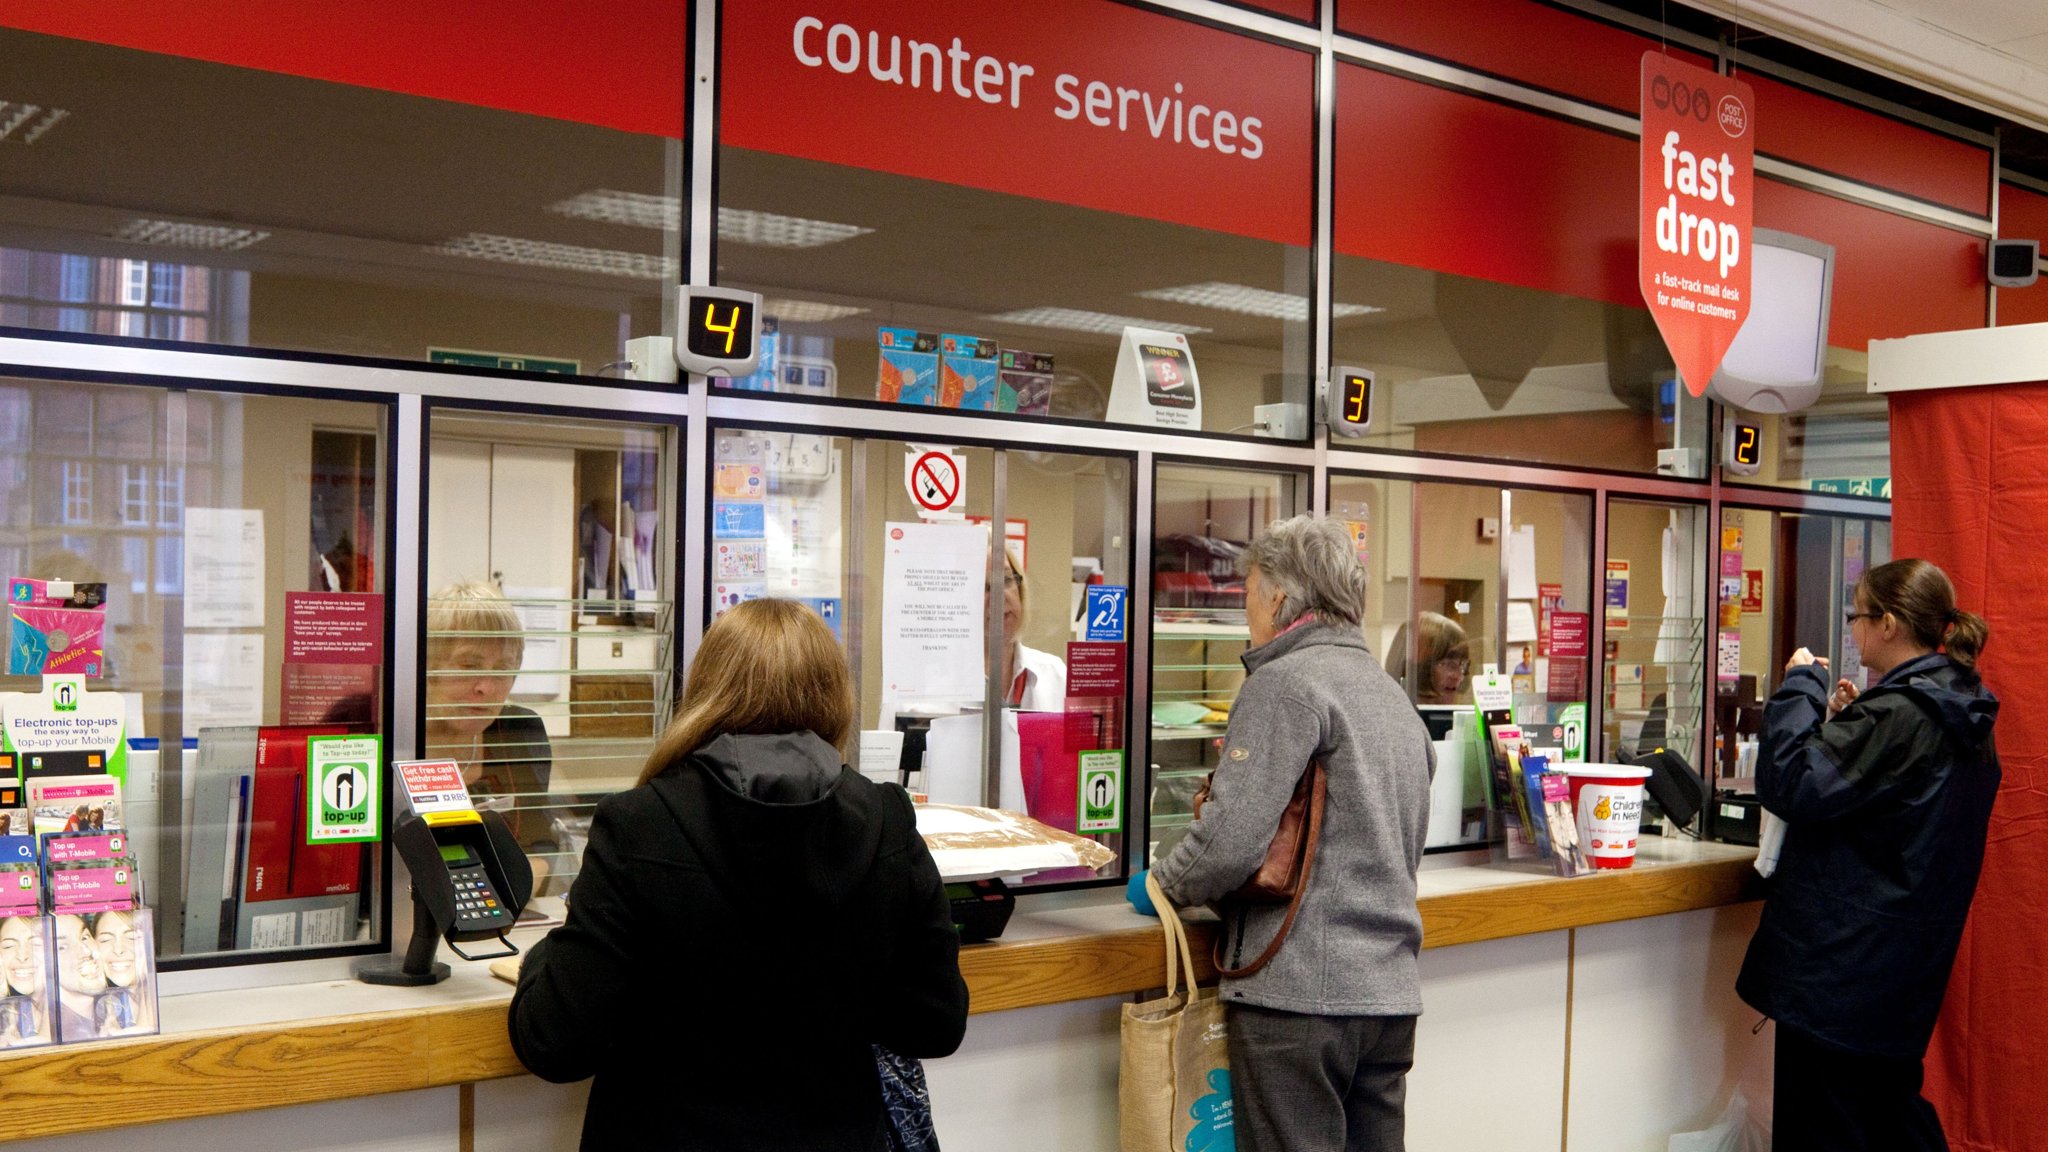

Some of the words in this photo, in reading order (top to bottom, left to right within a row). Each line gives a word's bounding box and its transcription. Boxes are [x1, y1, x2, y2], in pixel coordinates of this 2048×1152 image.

[794, 16, 1034, 108] counter
[1054, 82, 1264, 160] services
[1724, 103, 1741, 116] POST
[1720, 113, 1743, 128] OFFICE
[1662, 130, 1735, 206] fast
[1656, 194, 1739, 279] drop
[1655, 274, 1660, 284] a
[1662, 272, 1702, 294] fast-track
[1702, 282, 1720, 298] mail
[1721, 286, 1740, 301] desk
[1656, 290, 1669, 305] for
[1670, 293, 1695, 312] online
[1696, 301, 1737, 320] customers
[705, 303, 739, 354] 4
[1146, 346, 1180, 358] WINNER
[1347, 378, 1365, 422] 3
[1738, 428, 1754, 464] 2
[1111, 619, 1118, 628] T
[50, 647, 86, 669] Athletics
[14, 718, 72, 727] Electronic
[76, 718, 118, 728] top-ups
[18, 738, 52, 747] top-up
[55, 738, 78, 746] your
[82, 736, 115, 745] Mobile
[437, 765, 455, 773] cash
[406, 774, 454, 783] withdrawals
[451, 793, 468, 802] RBS
[1612, 802, 1640, 810] Childre
[324, 811, 365, 823] top-up
[1612, 812, 1620, 820] in
[69, 850, 96, 858] T-Mobile
